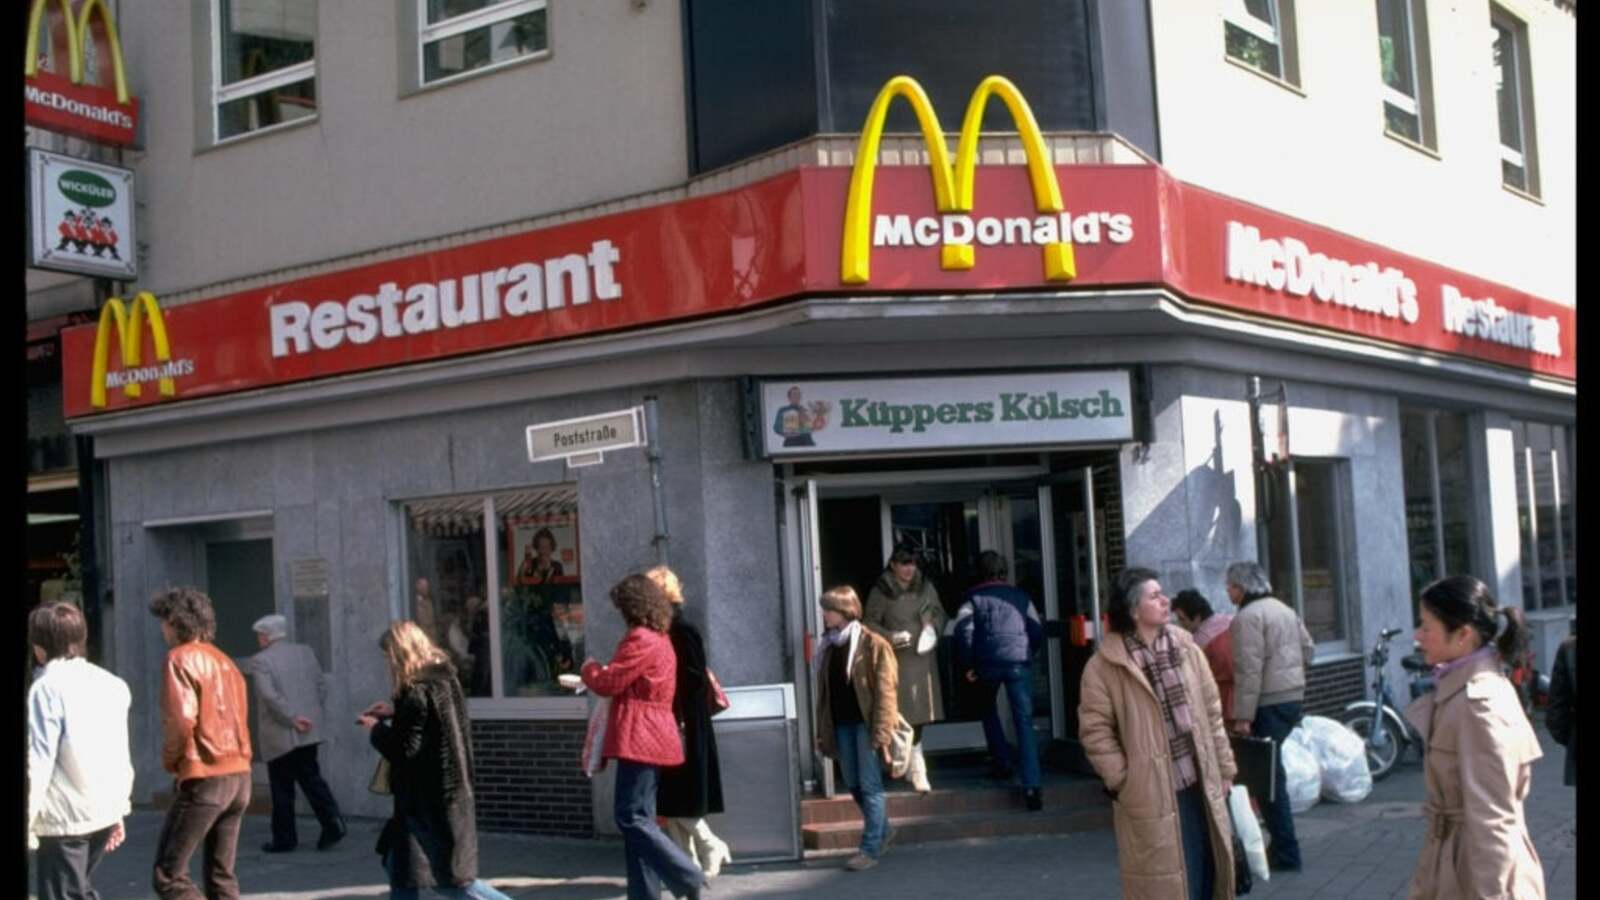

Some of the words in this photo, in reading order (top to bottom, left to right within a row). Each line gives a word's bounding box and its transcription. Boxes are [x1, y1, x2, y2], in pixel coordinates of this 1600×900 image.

[25, 85, 133, 128] McDonald's
[60, 179, 115, 199] WICKÜLER
[874, 212, 1134, 248] McDonald's
[271, 240, 621, 356] Restaurant
[1227, 222, 1418, 322] McDonald's
[1443, 285, 1561, 355] Restaurant
[105, 358, 195, 389] McDonald's
[839, 397, 996, 434] Küppers
[999, 388, 1125, 422] Kölsch
[553, 424, 618, 449] Poststraße
